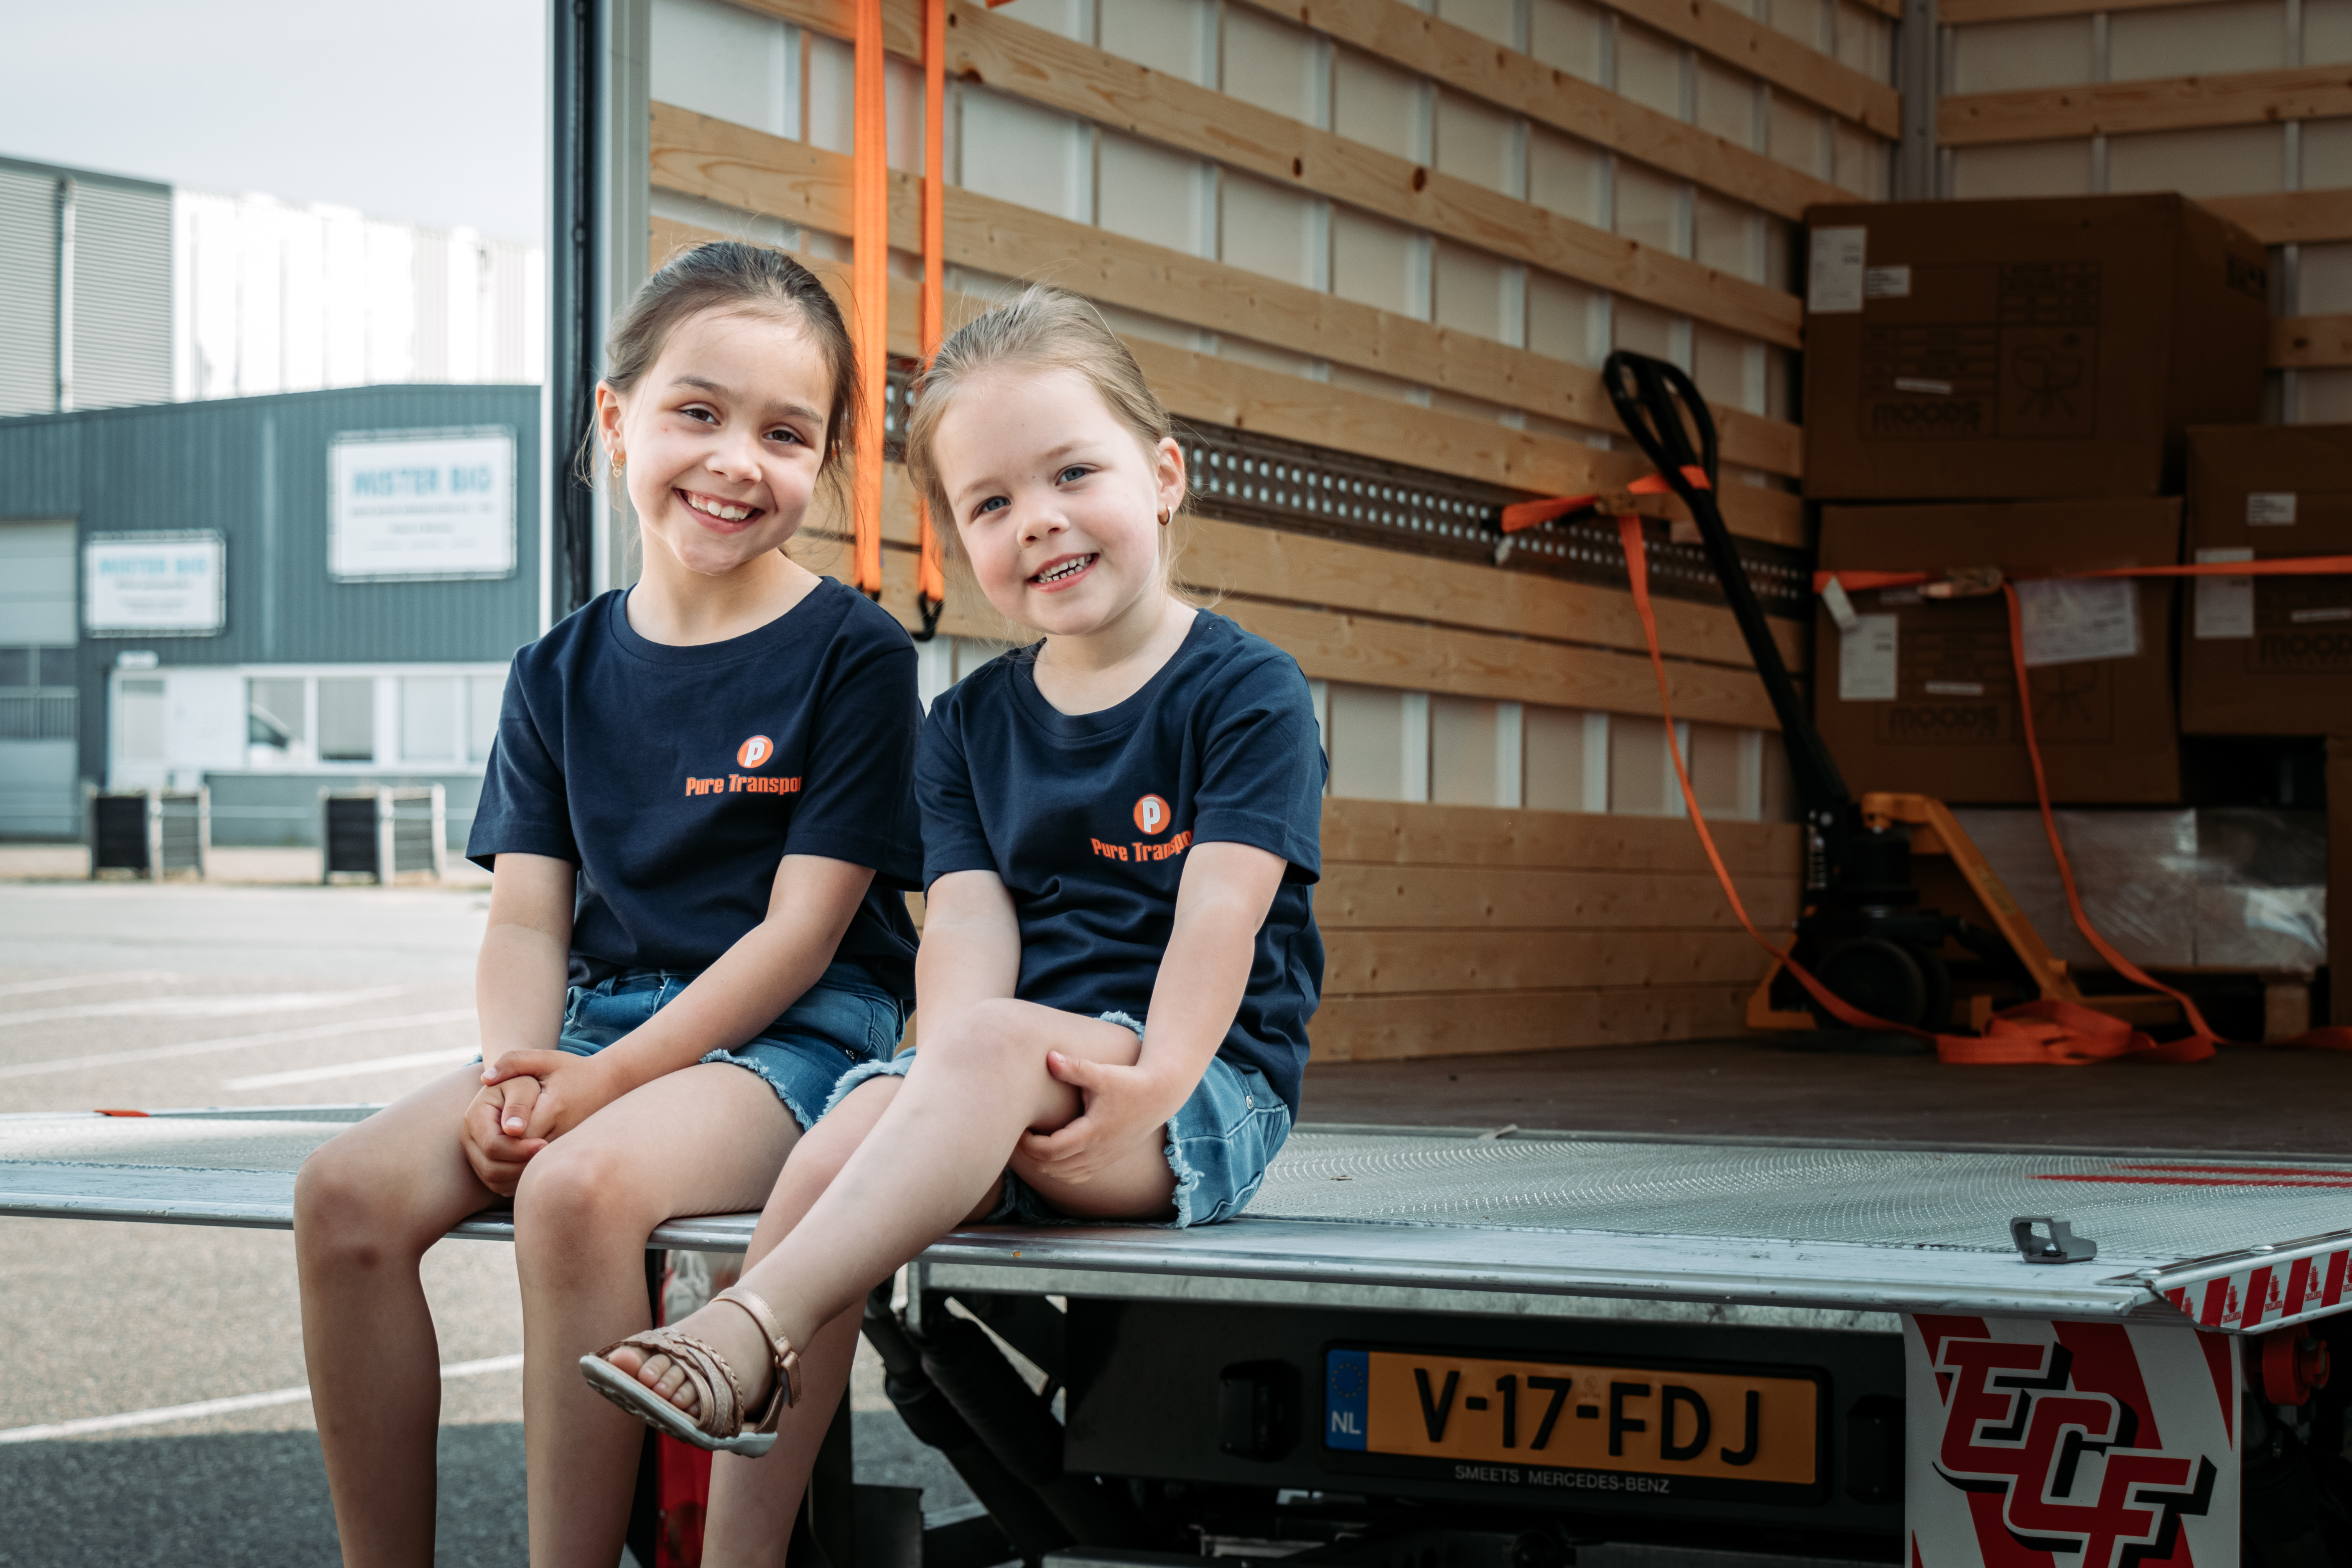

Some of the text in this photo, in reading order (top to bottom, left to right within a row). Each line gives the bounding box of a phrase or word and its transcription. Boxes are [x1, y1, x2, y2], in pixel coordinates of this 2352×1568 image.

[685, 777, 724, 796] Pure
[1090, 829, 1194, 862] Pure Transpo
[1331, 1410, 1362, 1435] NL
[1414, 1368, 1760, 1466] V-17-FDJ
[1455, 1465, 1670, 1494] SMEETS MERCEDES-BENZ
